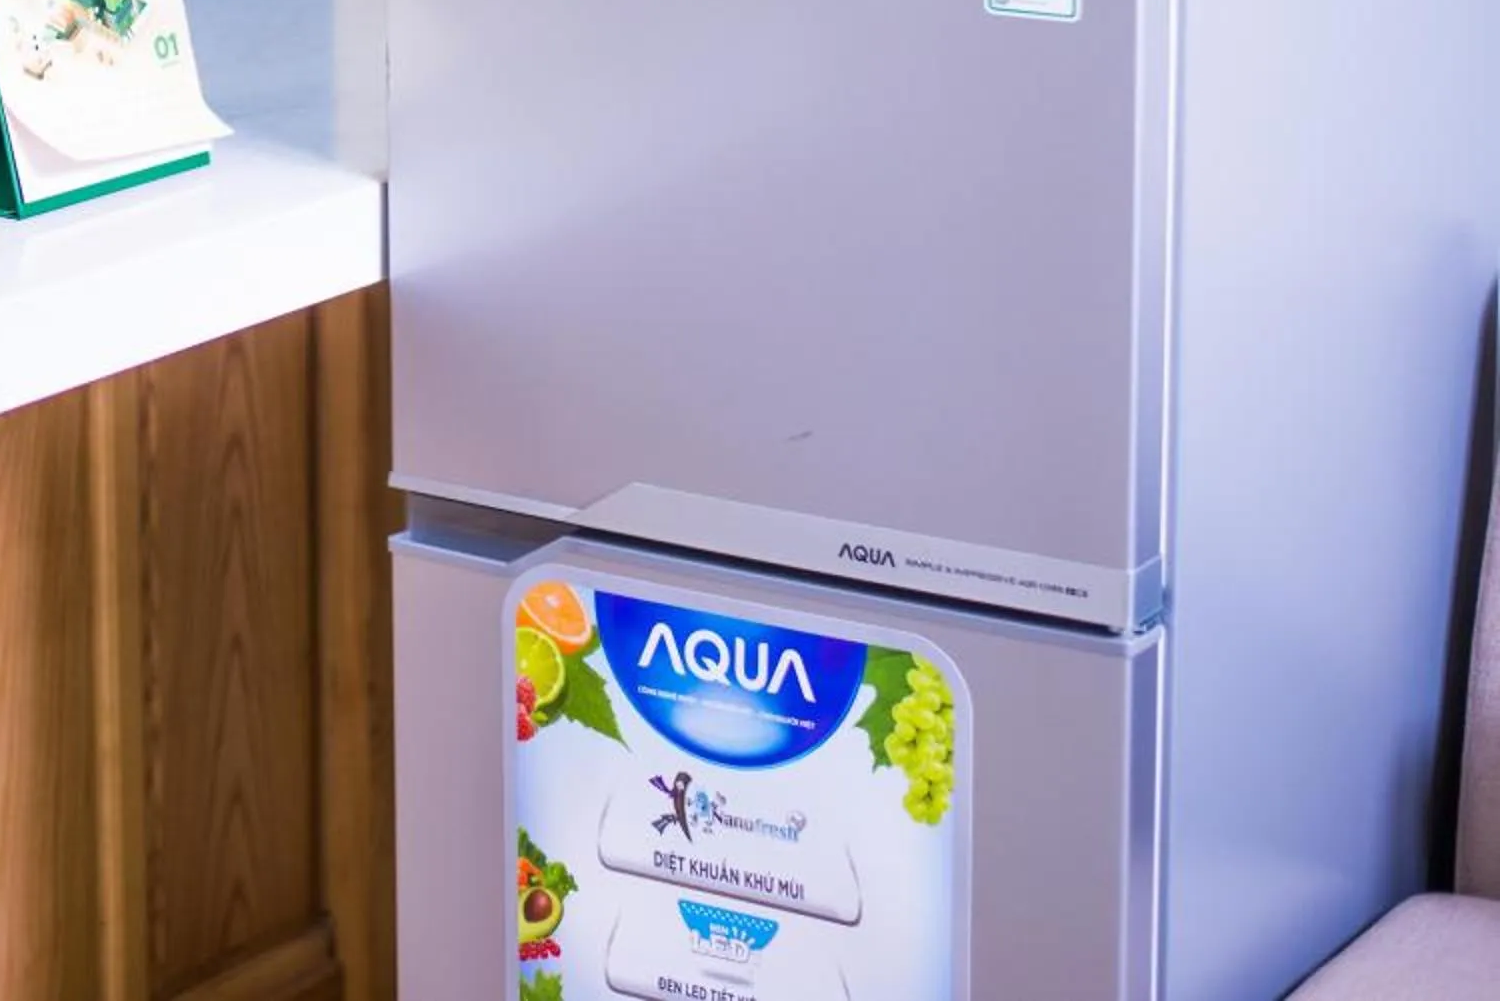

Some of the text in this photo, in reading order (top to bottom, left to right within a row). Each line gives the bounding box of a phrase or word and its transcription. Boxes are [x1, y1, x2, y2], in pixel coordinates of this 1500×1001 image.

[153, 32, 179, 59] 01
[838, 542, 895, 568] AQUA
[637, 622, 817, 704] AQUA
[653, 850, 686, 875] DIỆT
[685, 983, 707, 1000] LED
